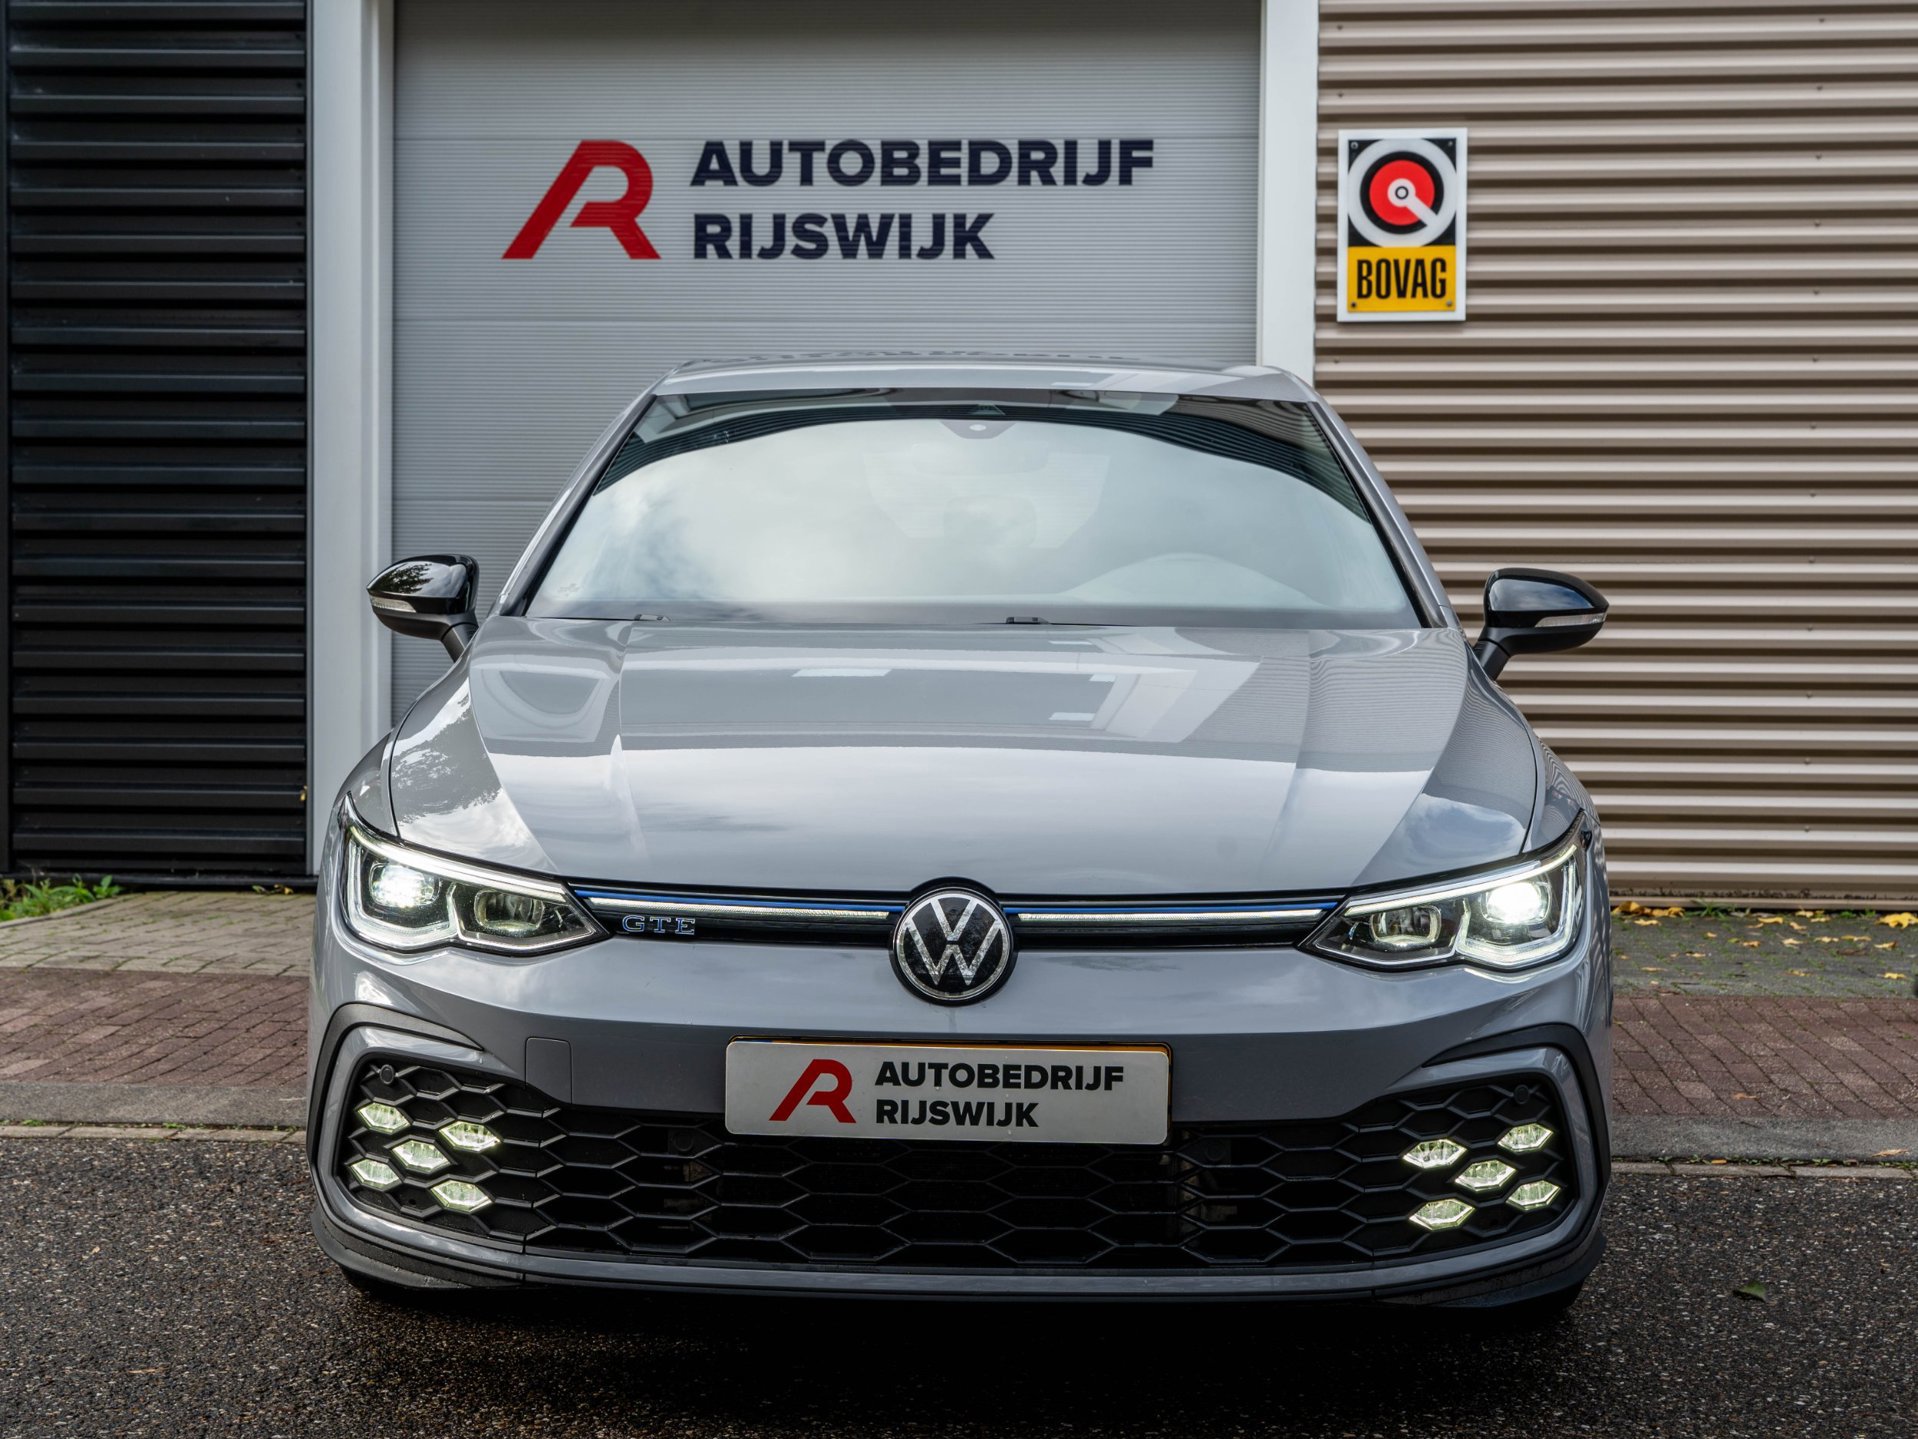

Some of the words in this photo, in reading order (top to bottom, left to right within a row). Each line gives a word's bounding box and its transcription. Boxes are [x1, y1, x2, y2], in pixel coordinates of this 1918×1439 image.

[690, 138, 1155, 187] AUTOBEDRIJF
[693, 212, 996, 259] RIJSWIJK
[1357, 258, 1447, 300] BOVAG
[621, 914, 696, 936] GTE
[874, 1061, 1125, 1092] AUTOBEDRIJF
[875, 1099, 1040, 1129] RIJSWIJK
